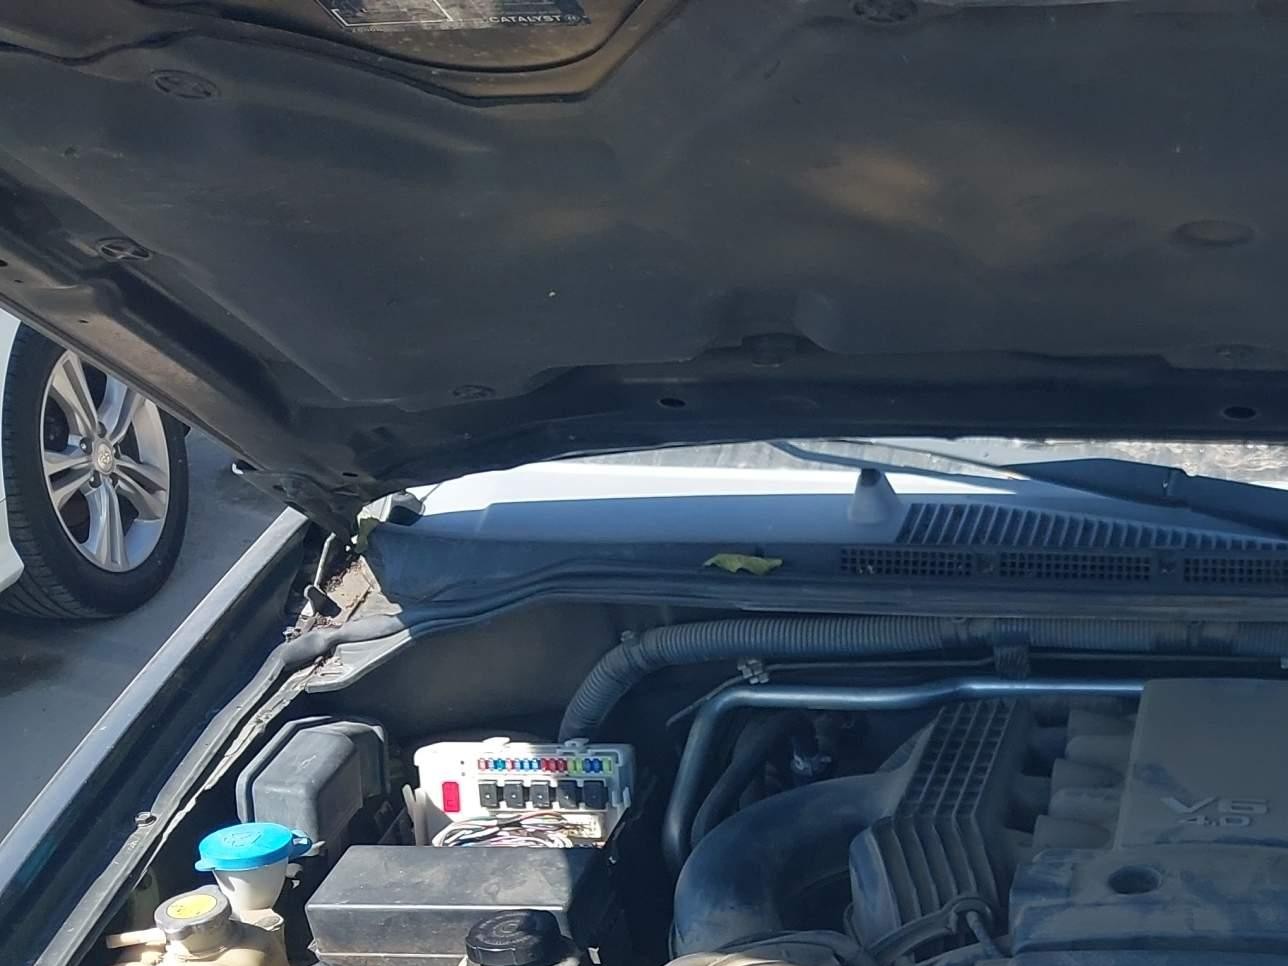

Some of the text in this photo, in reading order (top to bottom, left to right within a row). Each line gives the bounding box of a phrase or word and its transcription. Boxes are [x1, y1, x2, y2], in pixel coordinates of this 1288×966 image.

[488, 15, 561, 24] CATALYST
[1160, 797, 1268, 815] V6
[1178, 815, 1250, 827] 4.0
